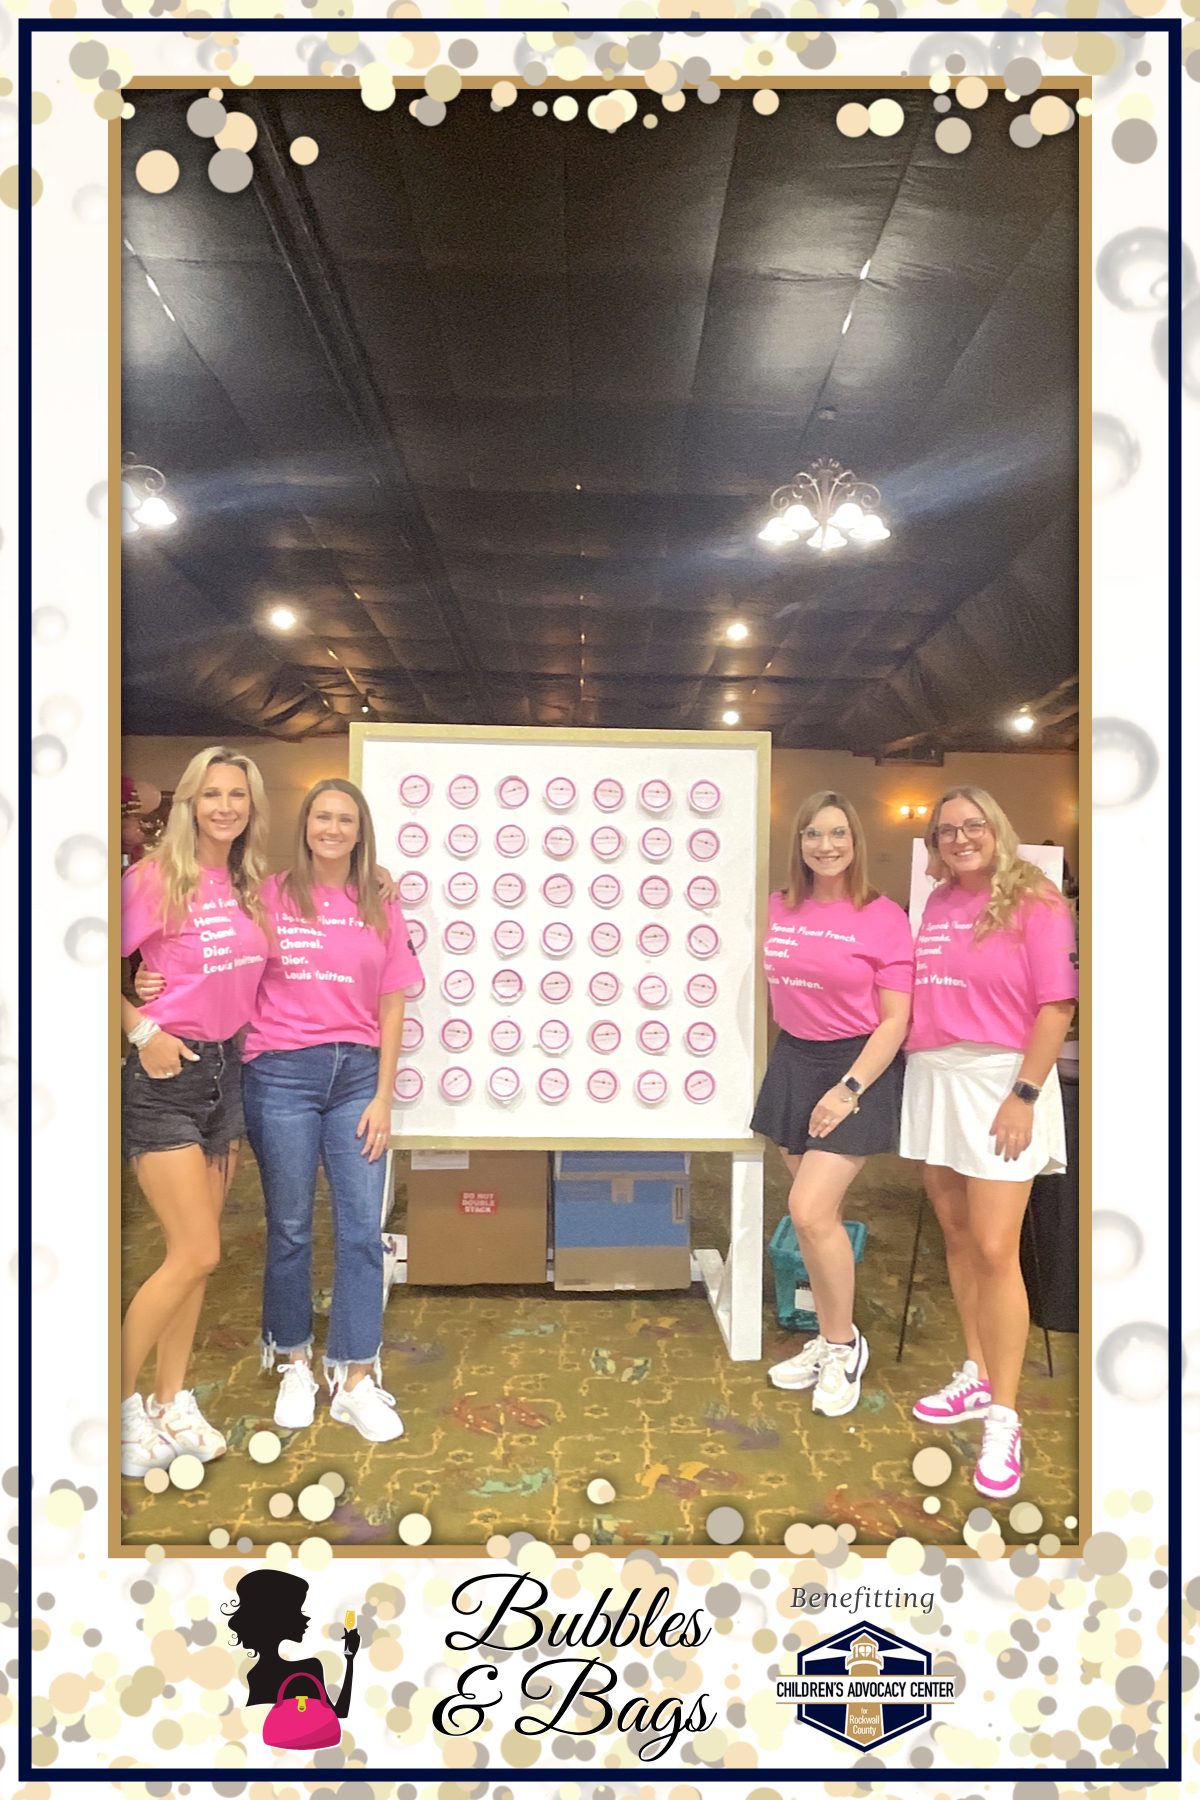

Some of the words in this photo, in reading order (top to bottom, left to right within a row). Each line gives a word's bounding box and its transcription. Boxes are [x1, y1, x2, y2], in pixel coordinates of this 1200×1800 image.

[771, 922, 796, 934] Speak
[797, 926, 825, 937] Fluent
[825, 930, 856, 943] French
[280, 938, 324, 950] Chanel.
[203, 945, 233, 959] Dior.
[281, 954, 309, 966] Dior.
[781, 976, 824, 990] Vuitton.
[463, 1192, 475, 1200] DO
[462, 1199, 496, 1207] DOUBLE
